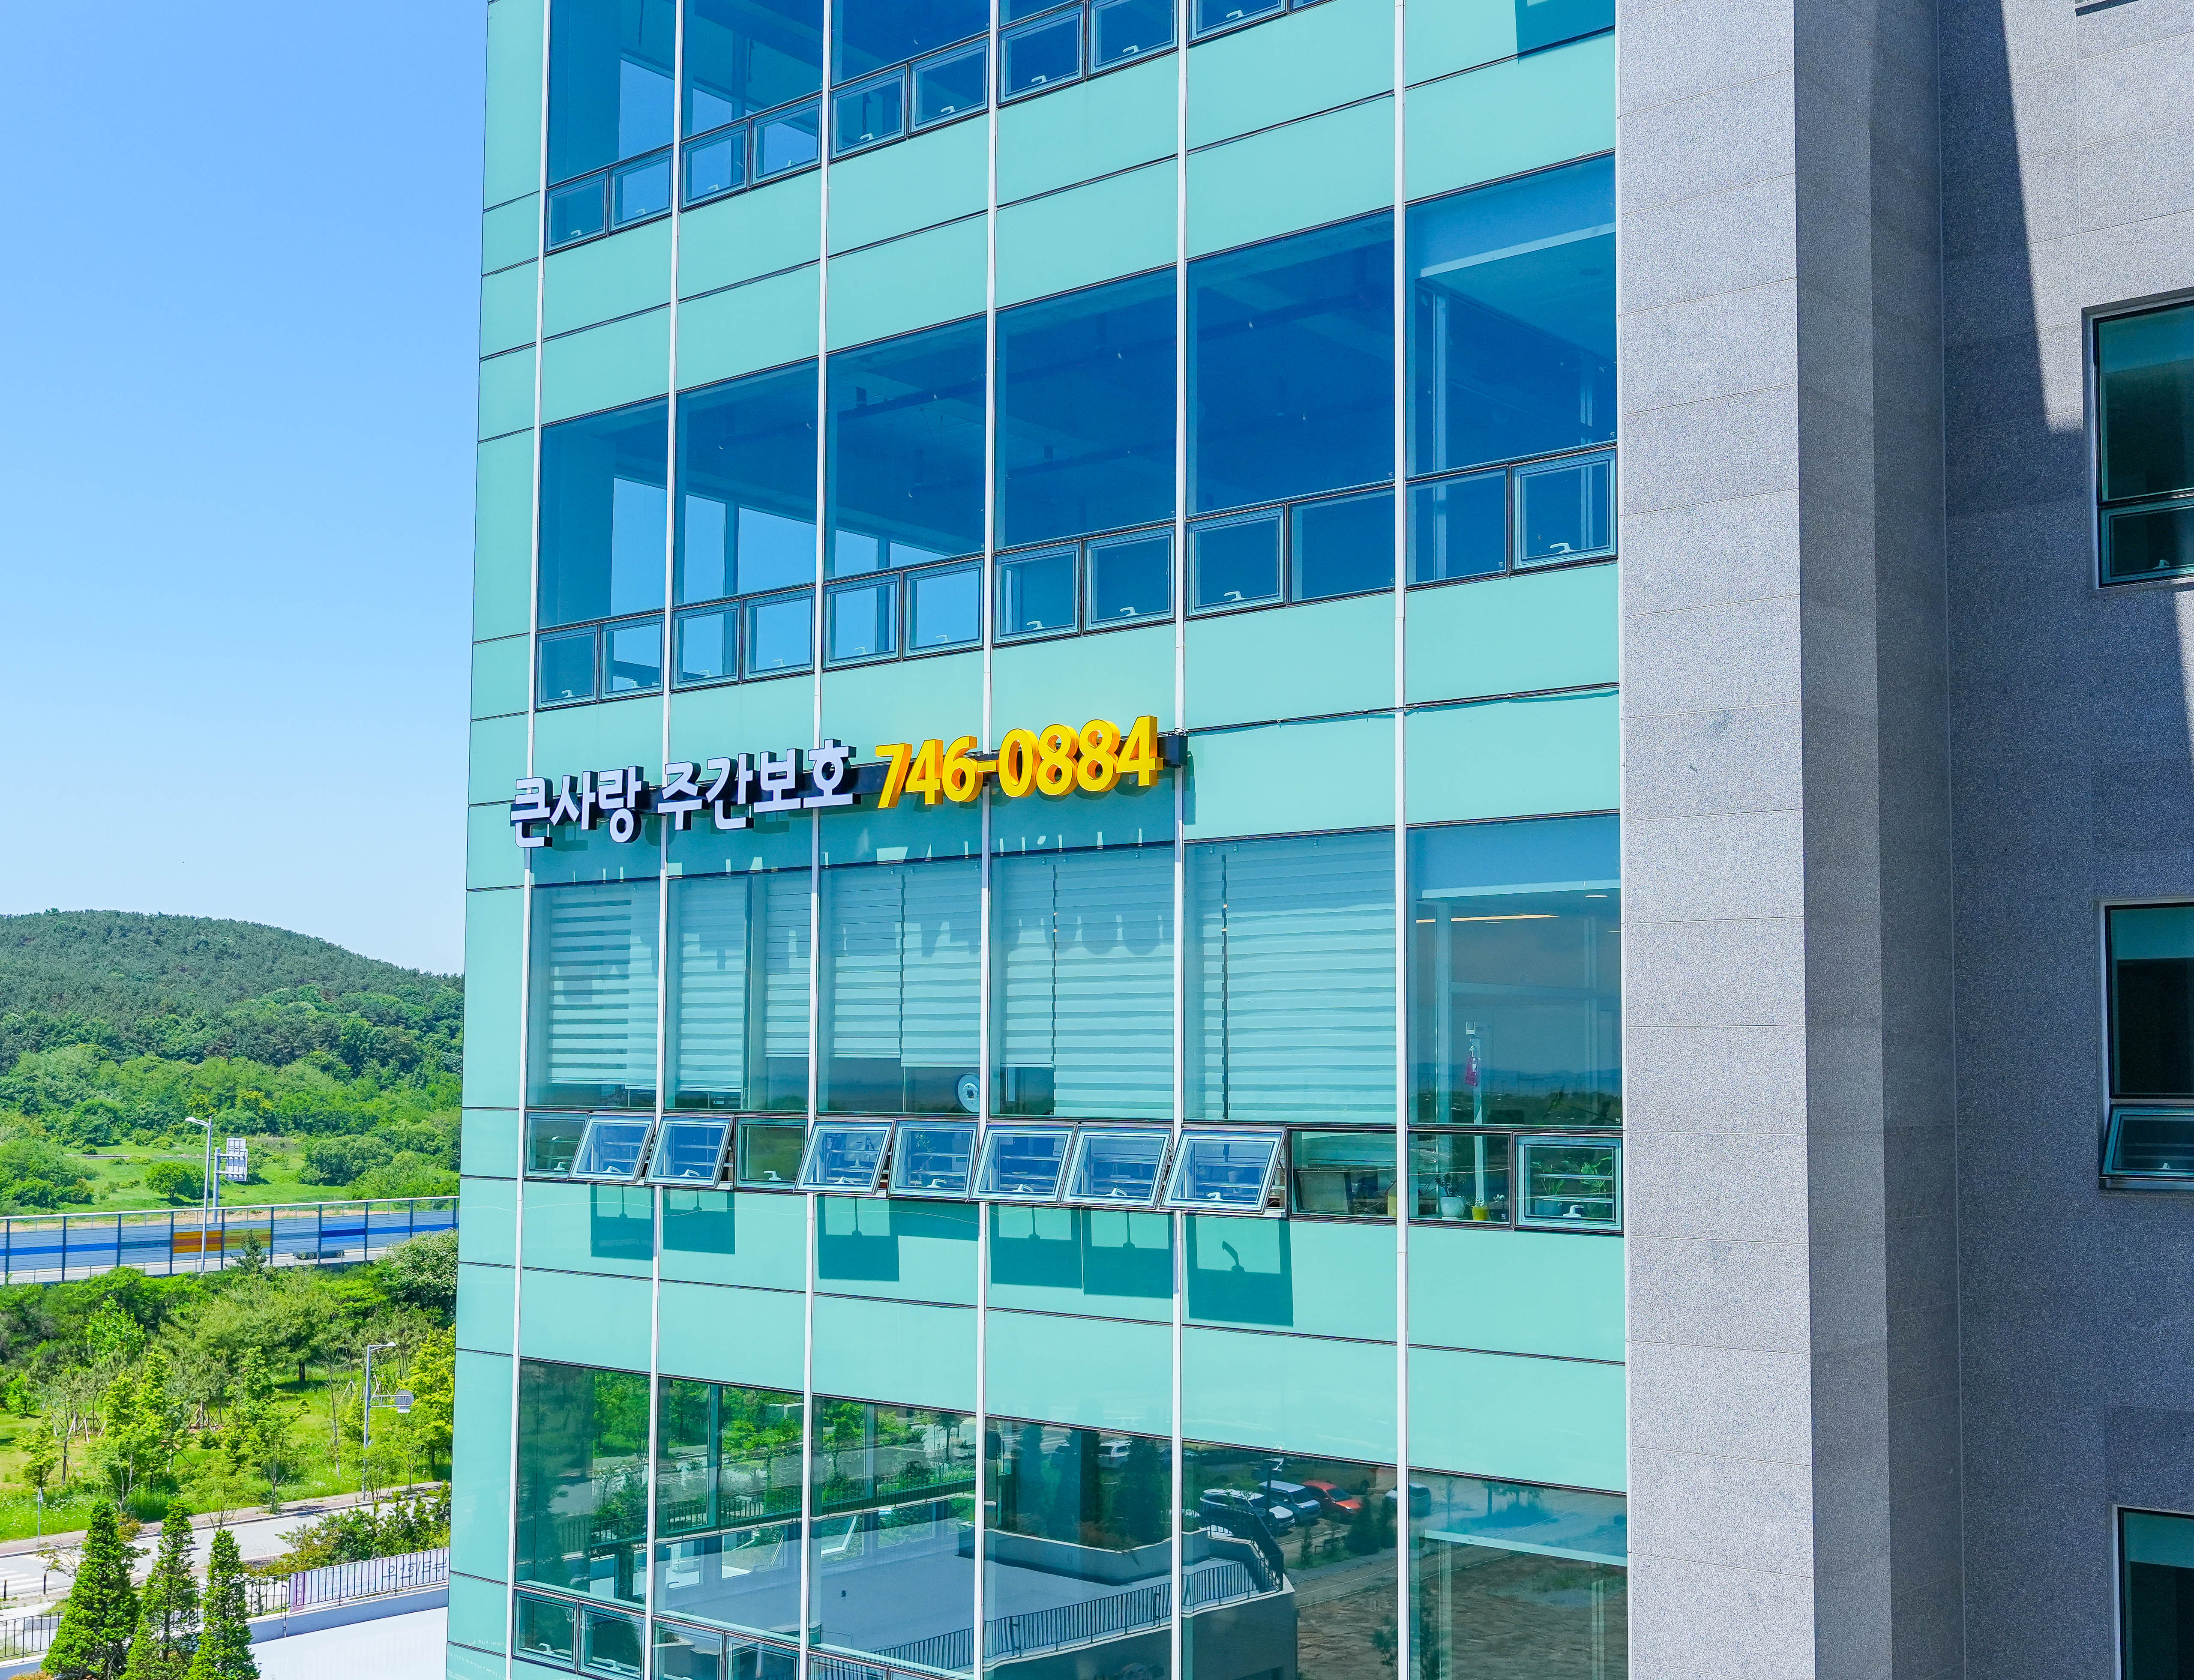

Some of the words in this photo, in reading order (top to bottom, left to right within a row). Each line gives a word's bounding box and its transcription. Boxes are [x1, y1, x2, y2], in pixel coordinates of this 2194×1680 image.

[510, 766, 644, 848] 큰사랑
[657, 739, 860, 830] 주간보호
[875, 715, 1163, 809] 746-0884
